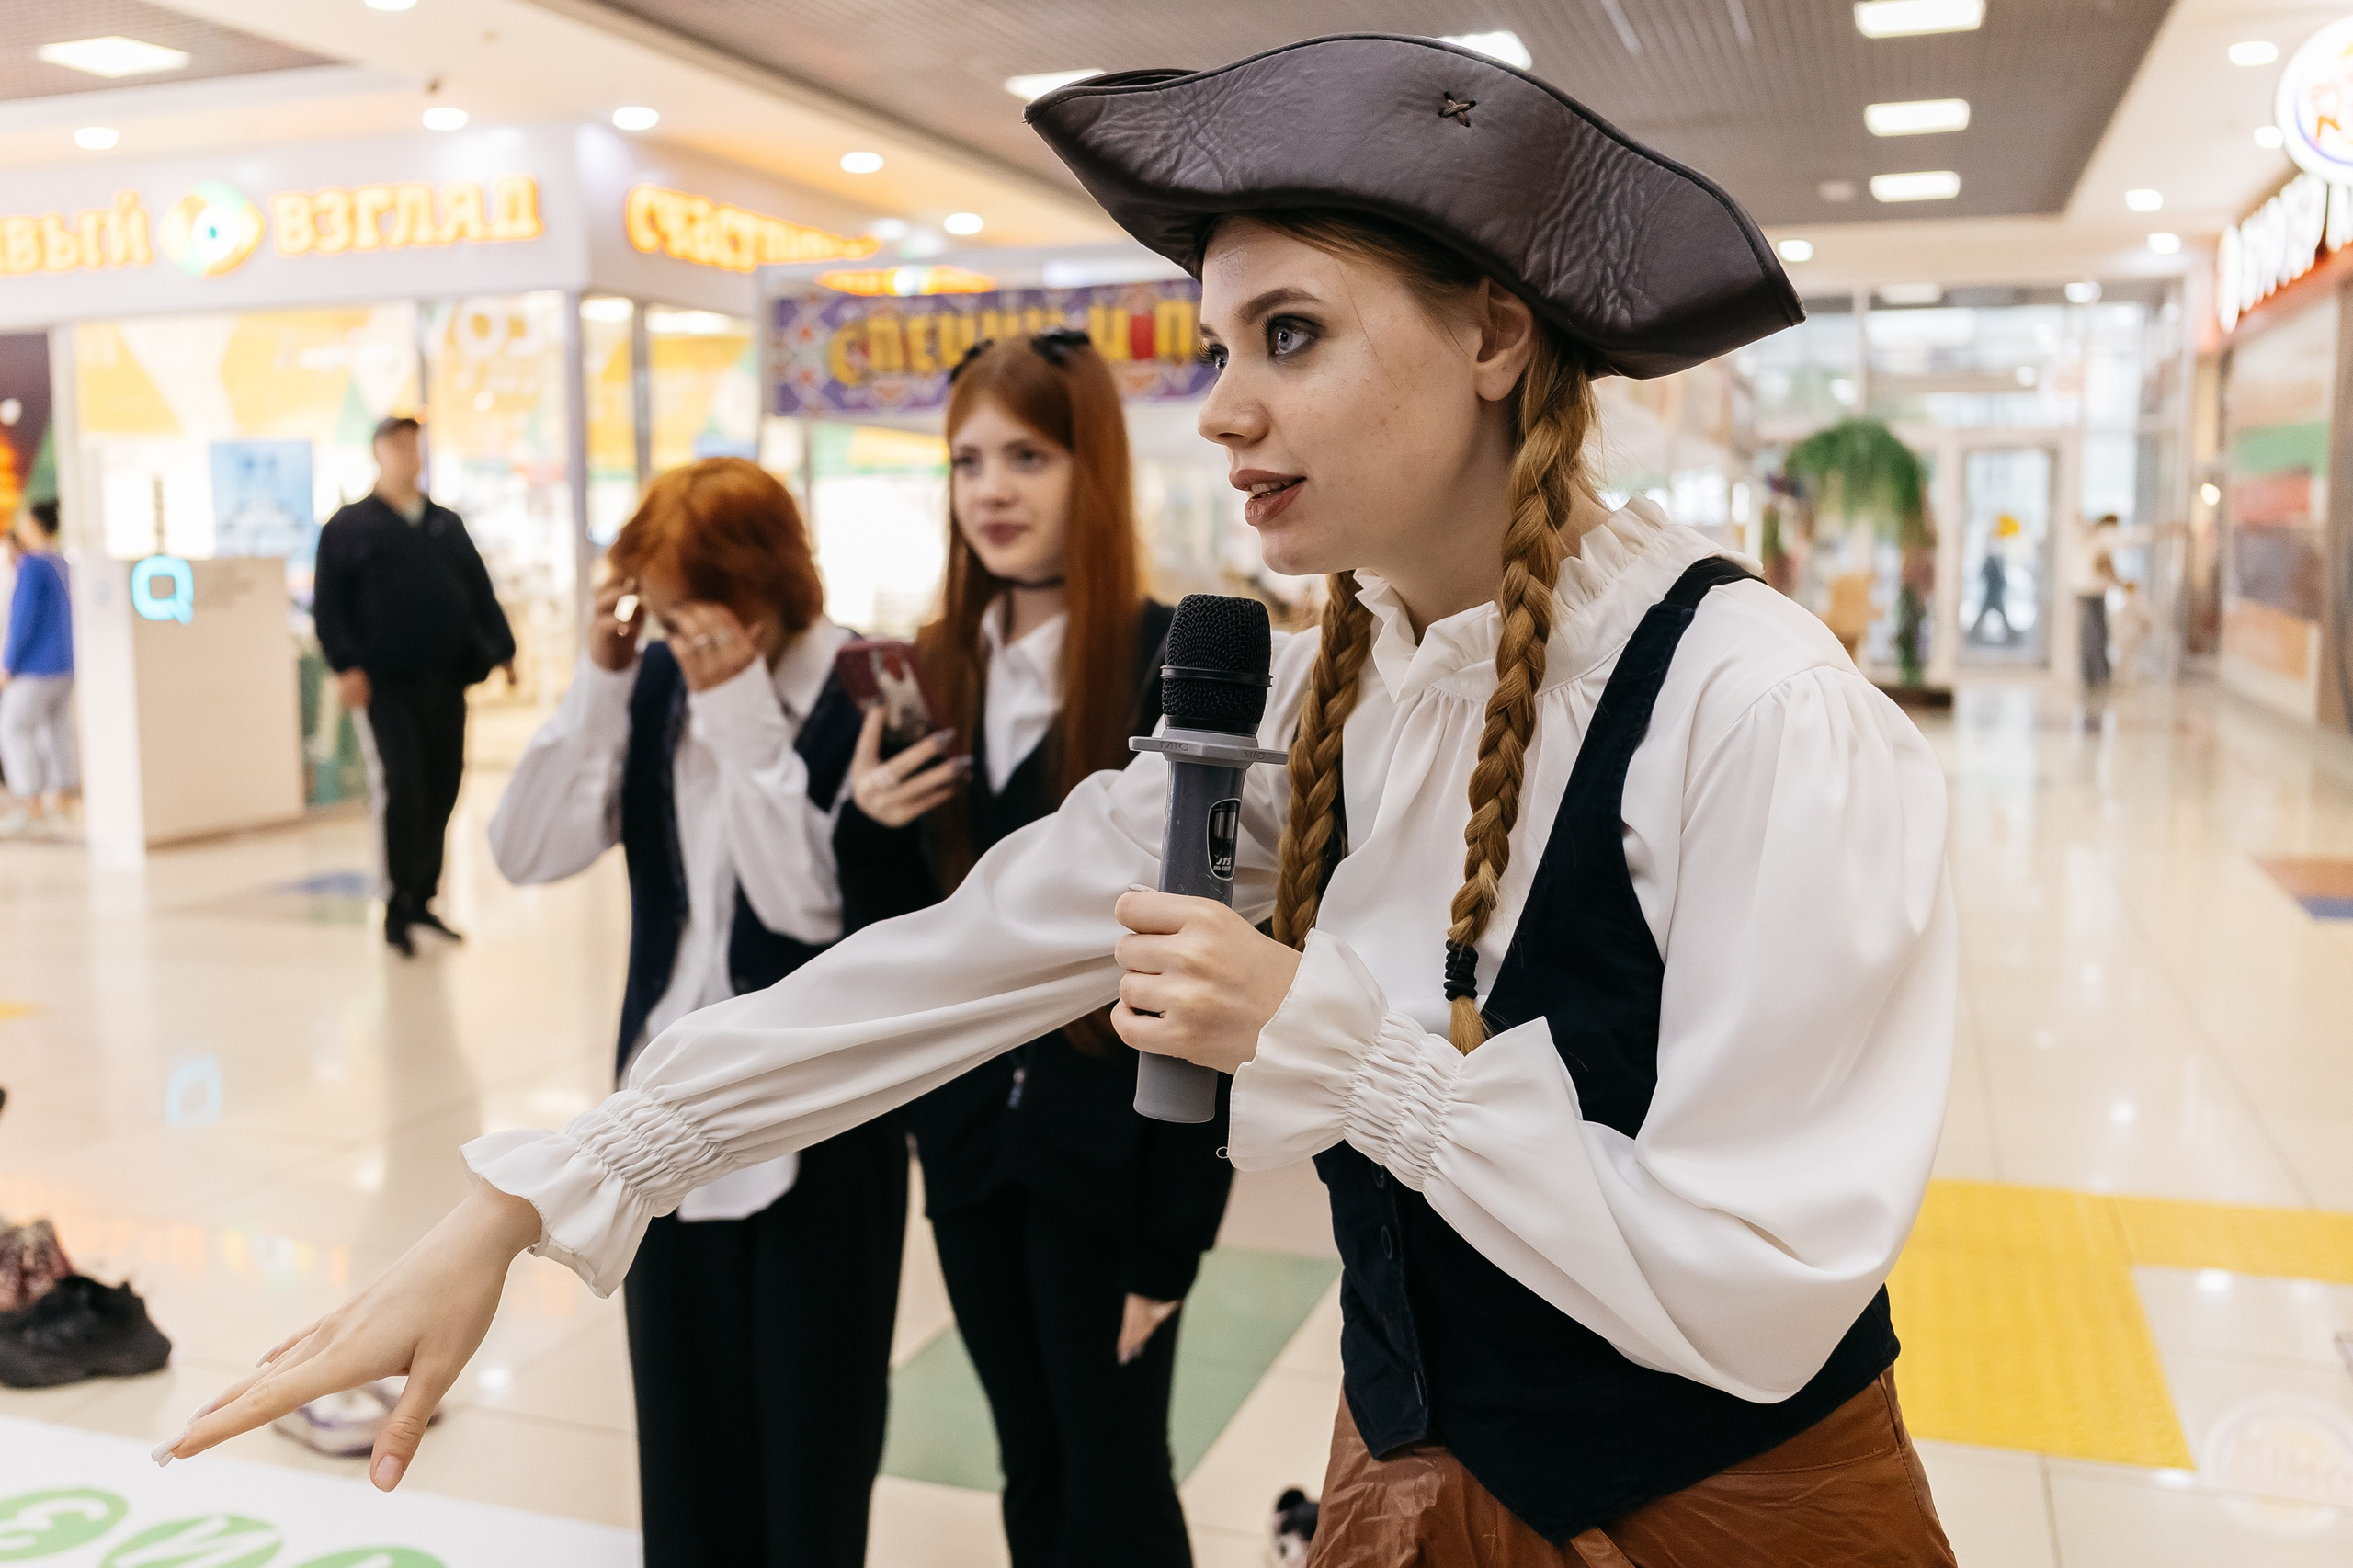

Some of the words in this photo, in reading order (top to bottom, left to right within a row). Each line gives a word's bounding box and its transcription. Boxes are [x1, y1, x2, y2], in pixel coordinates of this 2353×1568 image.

[271, 174, 543, 257] ВЗГЛЯД
[1160, 741, 1189, 752] MIC
[1244, 750, 1266, 760] MIC
[1216, 857, 1232, 865] JTS
